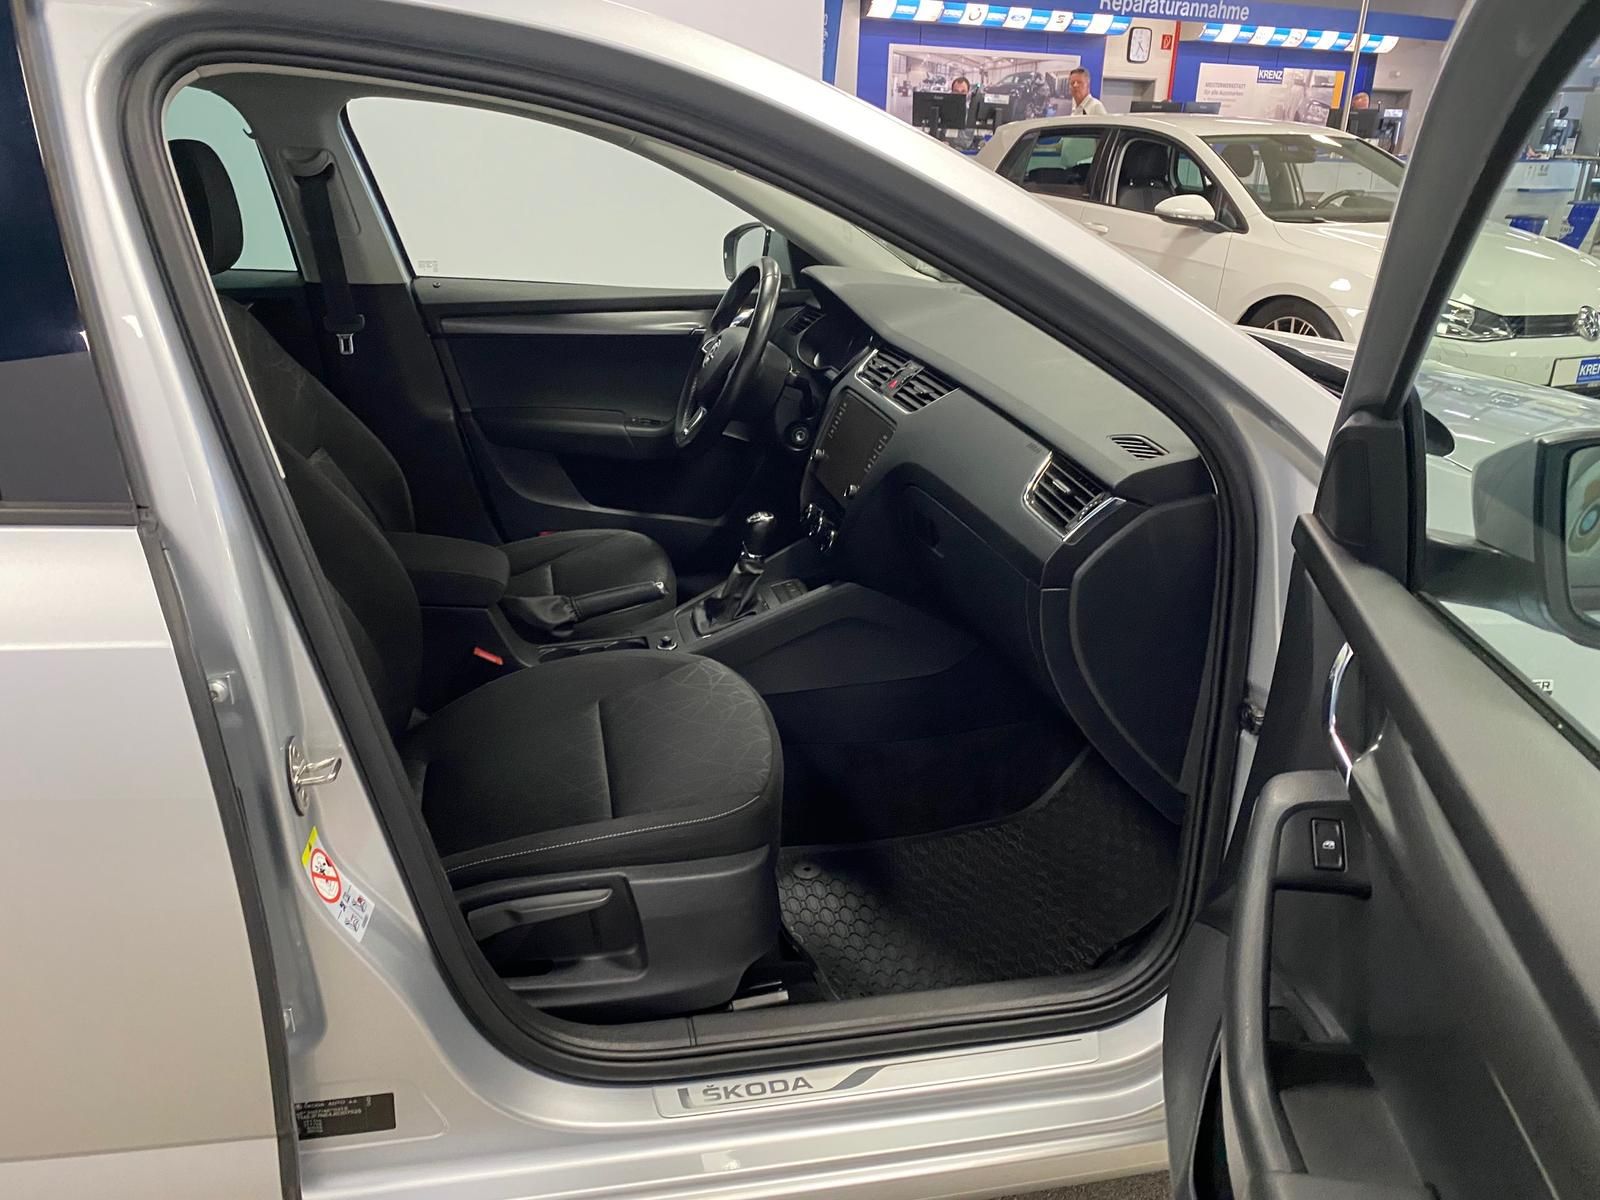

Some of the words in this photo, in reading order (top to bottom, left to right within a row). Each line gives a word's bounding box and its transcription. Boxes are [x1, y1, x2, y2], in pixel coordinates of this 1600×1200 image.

[1099, 0, 1250, 21] Reparaturannahme
[1258, 69, 1283, 80] KRENZ
[1579, 363, 1600, 376] KRE
[702, 1076, 814, 1102] ŠKODA
